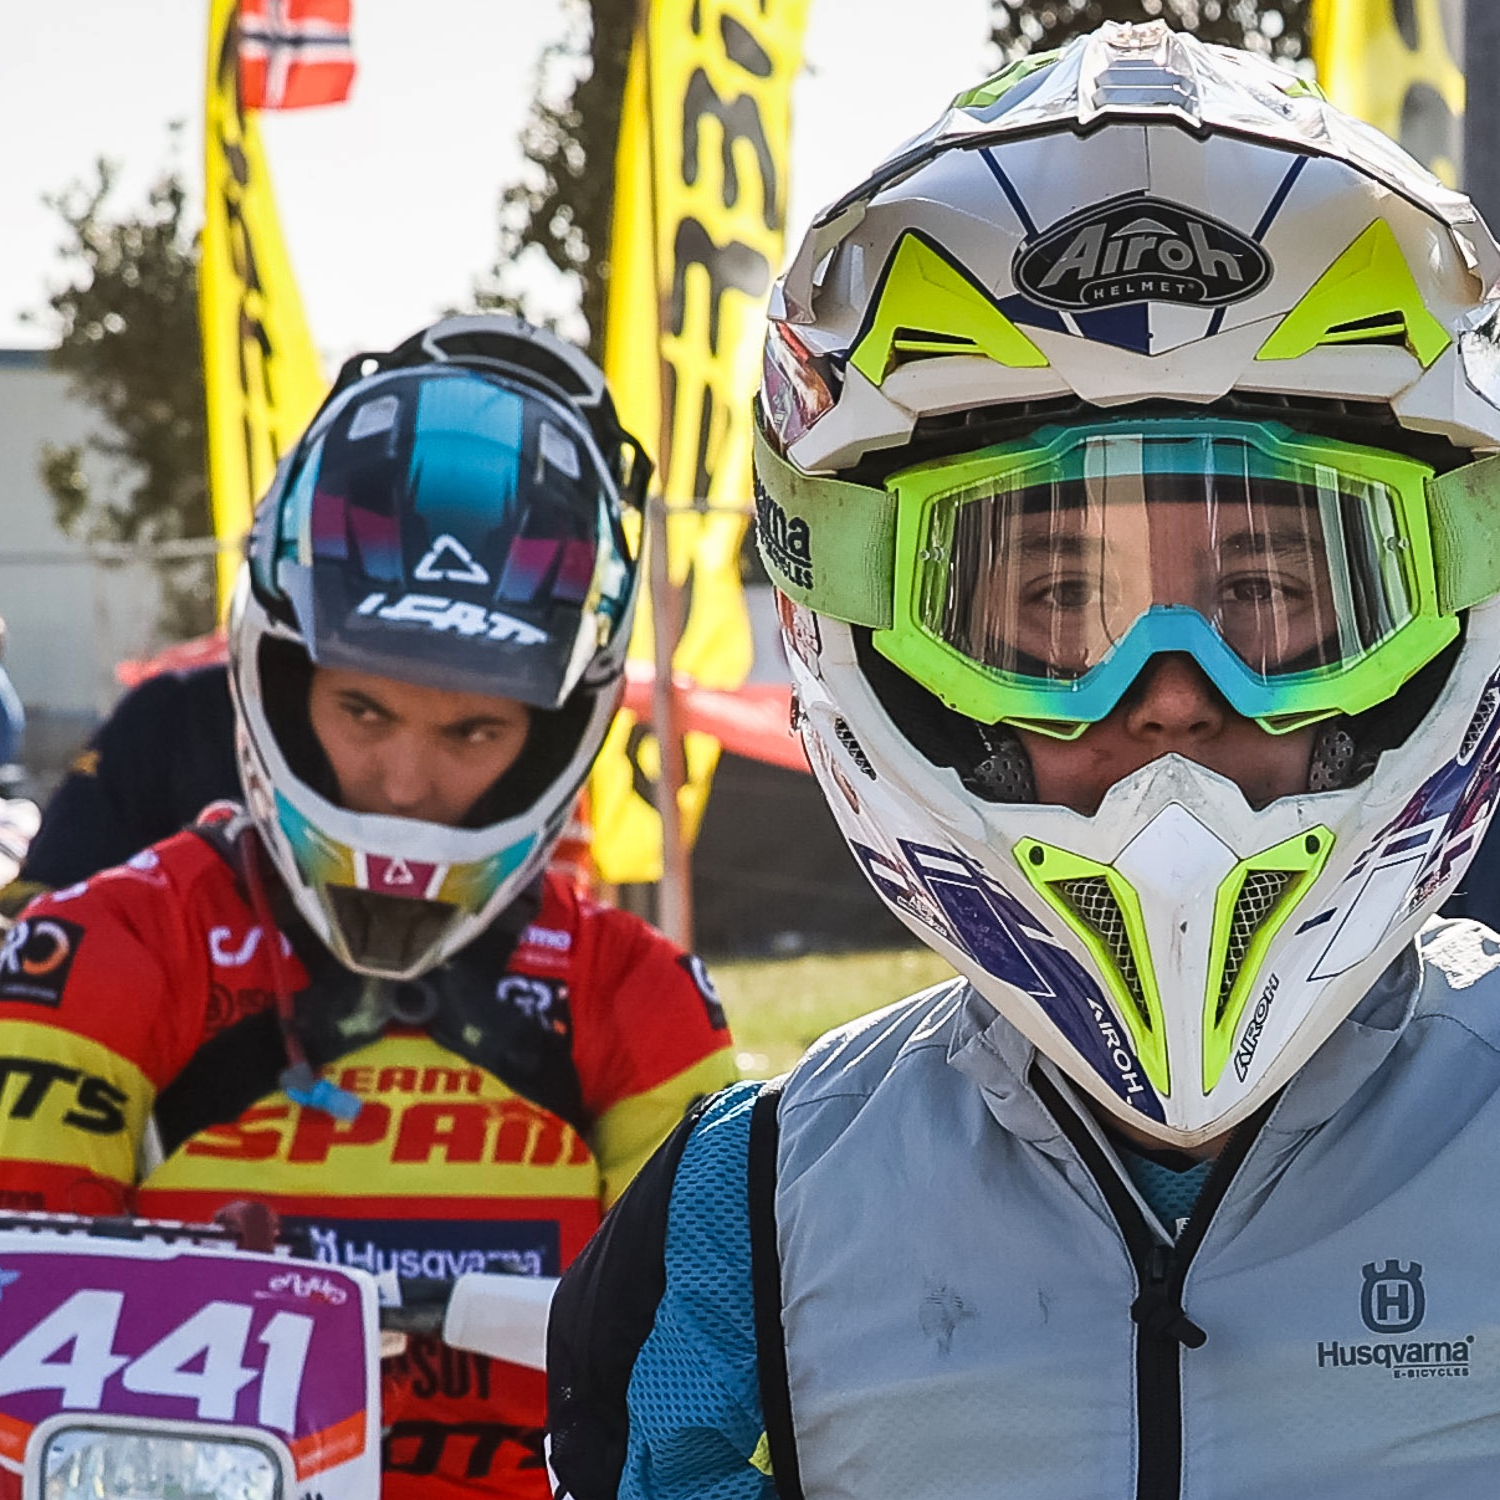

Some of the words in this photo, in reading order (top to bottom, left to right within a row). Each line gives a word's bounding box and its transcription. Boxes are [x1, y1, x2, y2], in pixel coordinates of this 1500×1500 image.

[1038, 220, 1244, 289] Airoh
[1093, 280, 1186, 300] HELMET
[1086, 997, 1144, 1094] AIROH
[1233, 972, 1280, 1083] AIROH
[321, 1065, 485, 1094] EAM
[1316, 1334, 1469, 1368] Husqvarna
